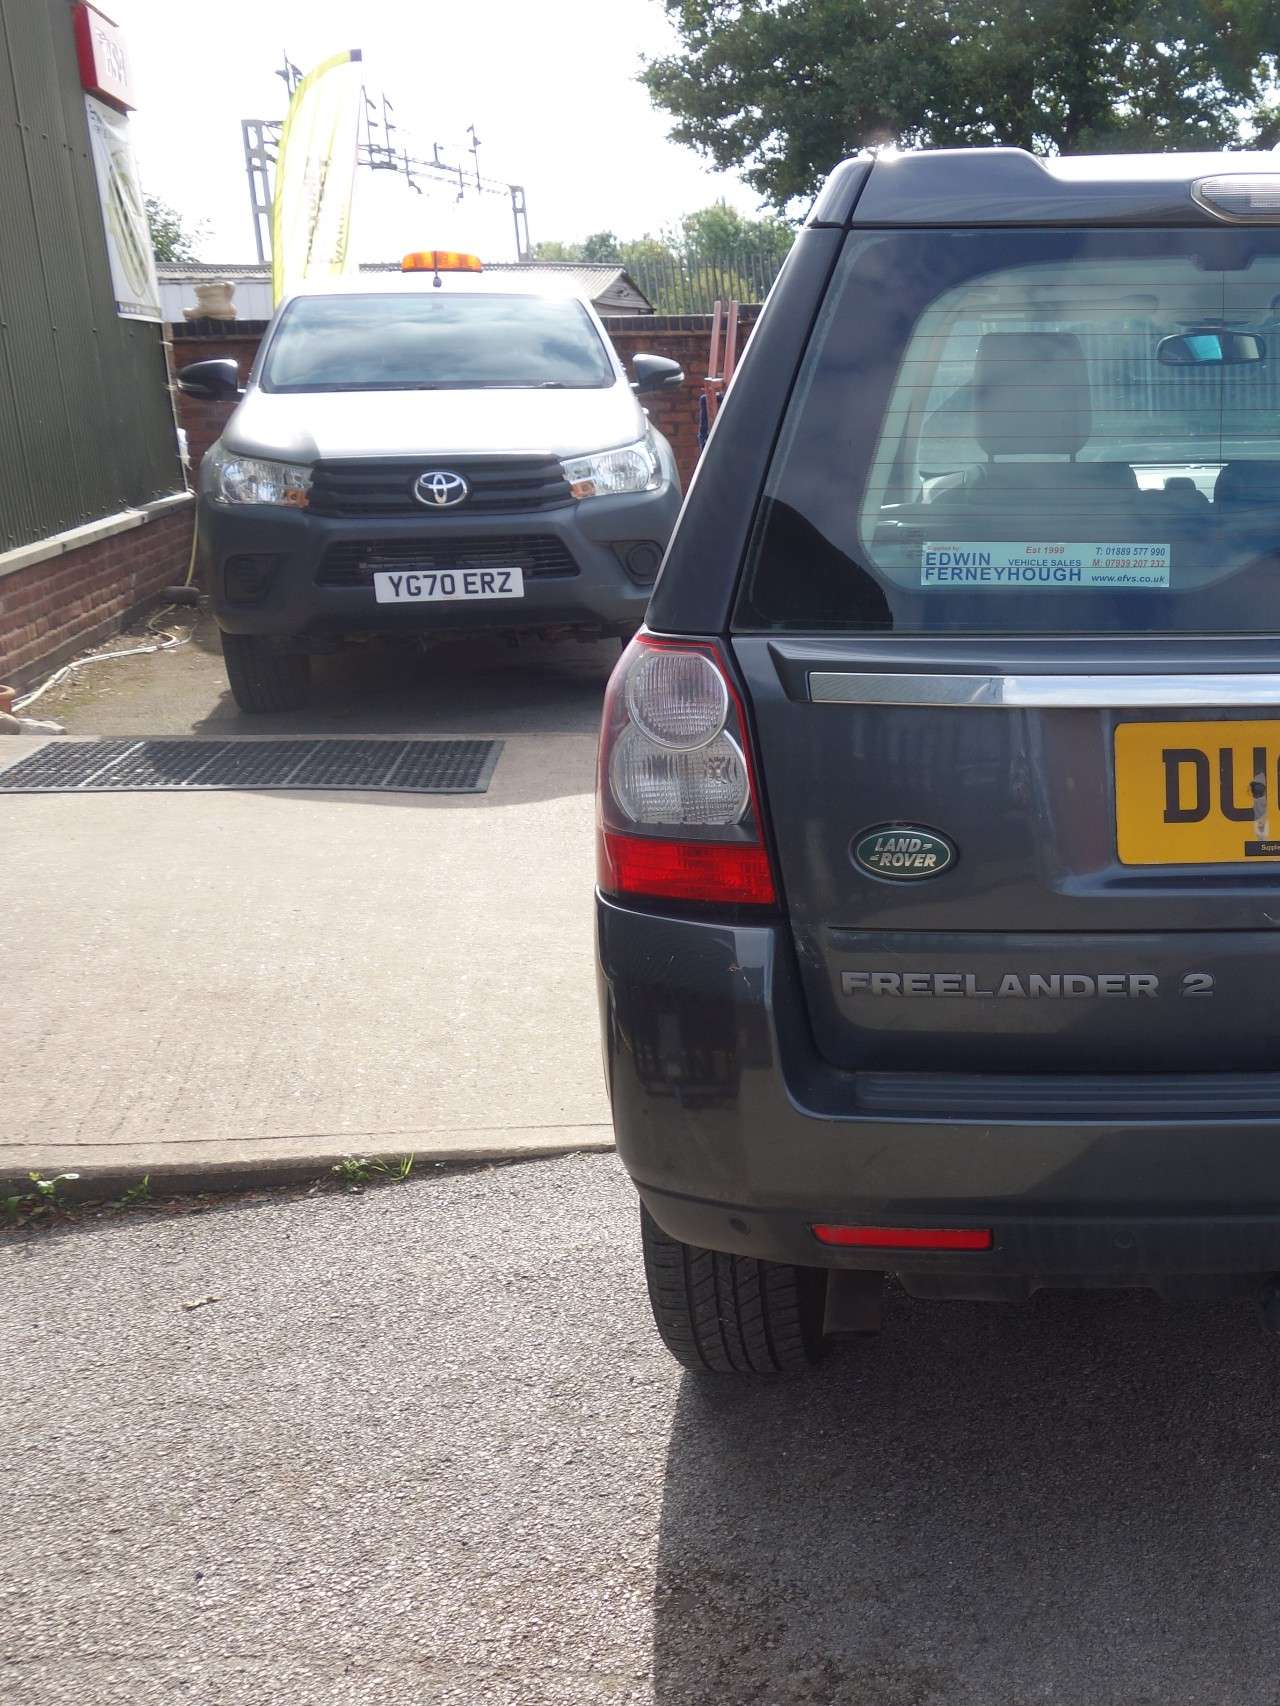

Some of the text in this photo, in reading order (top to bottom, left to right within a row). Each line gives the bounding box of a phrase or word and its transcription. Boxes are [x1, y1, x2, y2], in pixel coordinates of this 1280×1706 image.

[1026, 546, 1065, 554] Est 1999
[1096, 547, 1166, 556] T: 01889 577 990
[926, 552, 991, 566] EDWIN
[1008, 559, 1081, 567] VEHICLE SALES
[1092, 559, 1102, 568] M:
[925, 567, 1082, 581] FERNEYHOUGH
[1091, 574, 1166, 583] www.efvs.co.uk
[388, 571, 513, 597] YG70 ERZ
[875, 838, 922, 852] LAND
[880, 852, 937, 867] ROVER
[840, 970, 1216, 999] FREELANDER 2
